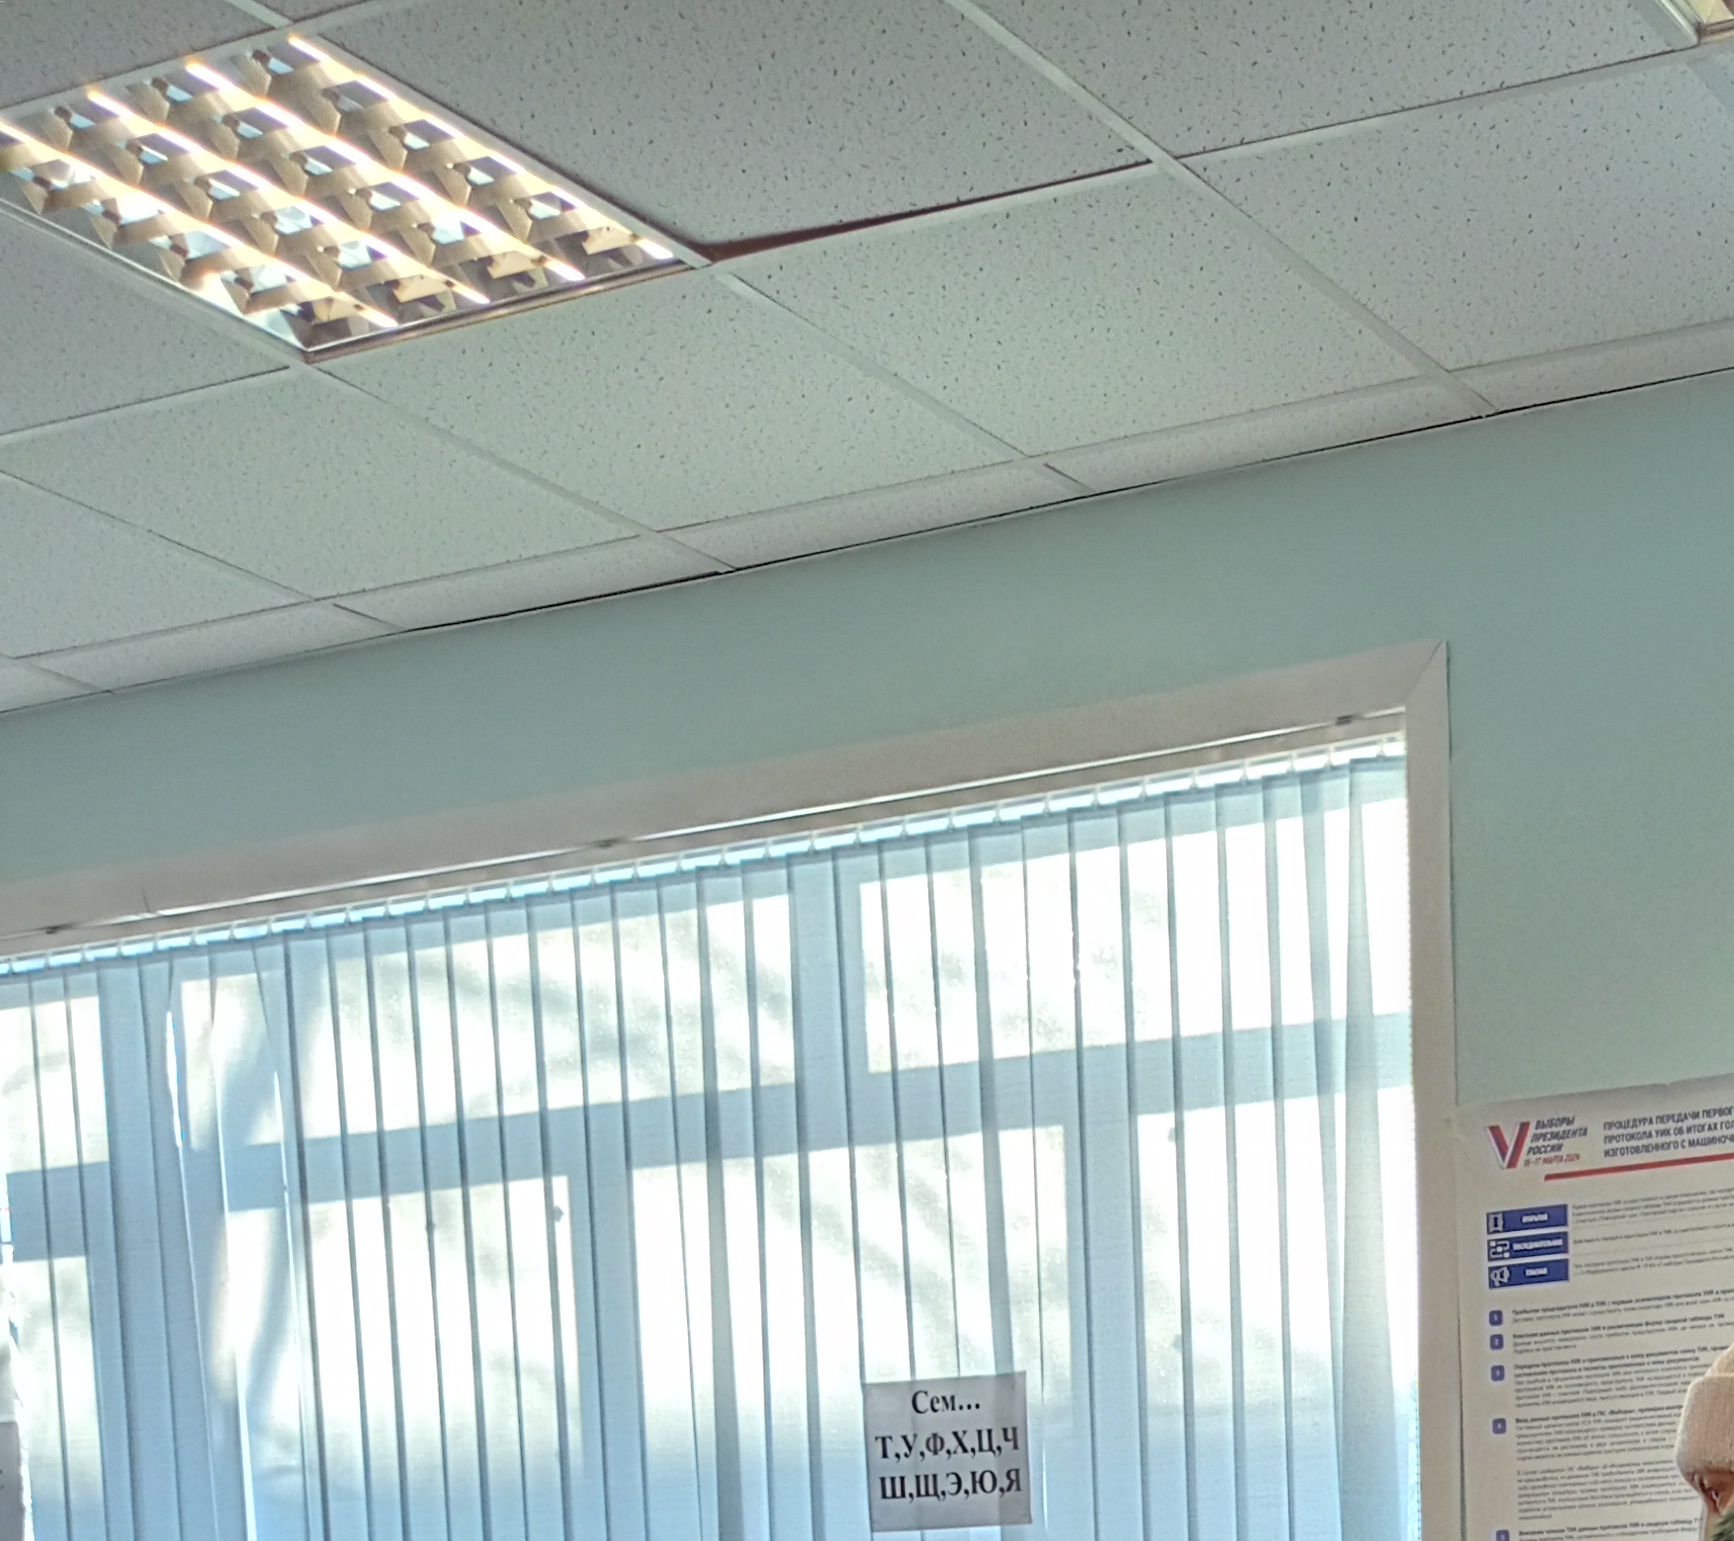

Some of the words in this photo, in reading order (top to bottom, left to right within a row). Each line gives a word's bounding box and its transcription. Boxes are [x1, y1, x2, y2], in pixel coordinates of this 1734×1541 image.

[1535, 1116, 1575, 1130] ВЫБОРЫ
[1604, 1116, 1654, 1131] ПРОЦЕДУРА
[1655, 1111, 1700, 1125] ПЕРЕДАЧИ
[1531, 1127, 1588, 1143] ПРЕЗИДЕНТА
[1604, 1131, 1653, 1145] ПРОТОКОЛА
[1654, 1129, 1671, 1139] УИК
[1673, 1127, 1684, 1136] ОБ
[1686, 1123, 1718, 1135] ИТОГАХ
[1527, 1143, 1563, 1156] РОССИИ
[1604, 1142, 1679, 1158] ИЗГОТОВЛЕННОГО
[911, 1390, 980, 1414] Сем...
[875, 1427, 1020, 1463] Т,У,Ф,Х,Ц,Ч
[879, 1468, 1022, 1503] Ш,Щ,Э,Ю,Я
